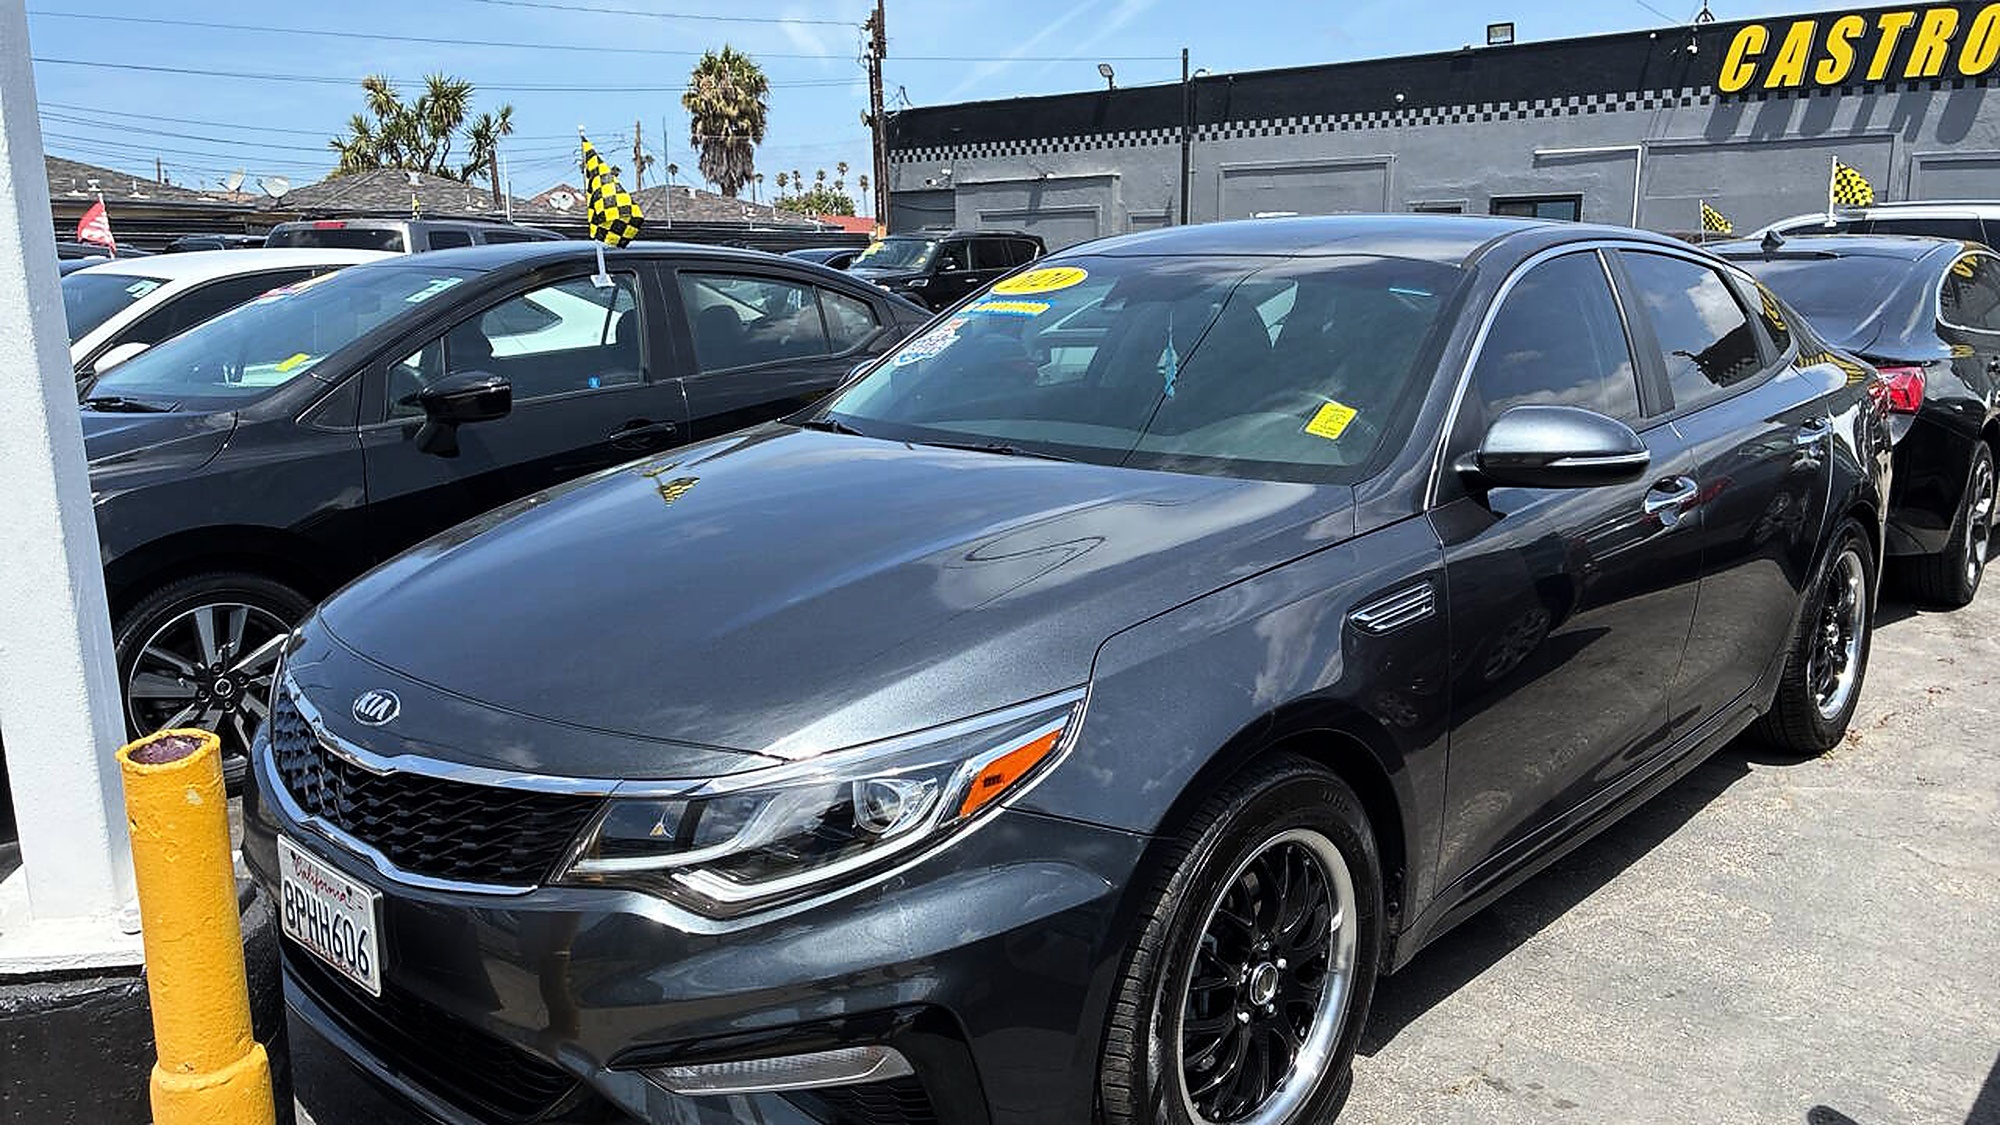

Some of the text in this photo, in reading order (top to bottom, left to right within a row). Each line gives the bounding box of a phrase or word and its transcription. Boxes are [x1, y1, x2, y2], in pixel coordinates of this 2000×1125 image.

[1718, 3, 2000, 93] CASTRO
[355, 691, 392, 720] KIA
[293, 855, 347, 904] California
[283, 879, 370, 977] 8PHH606
